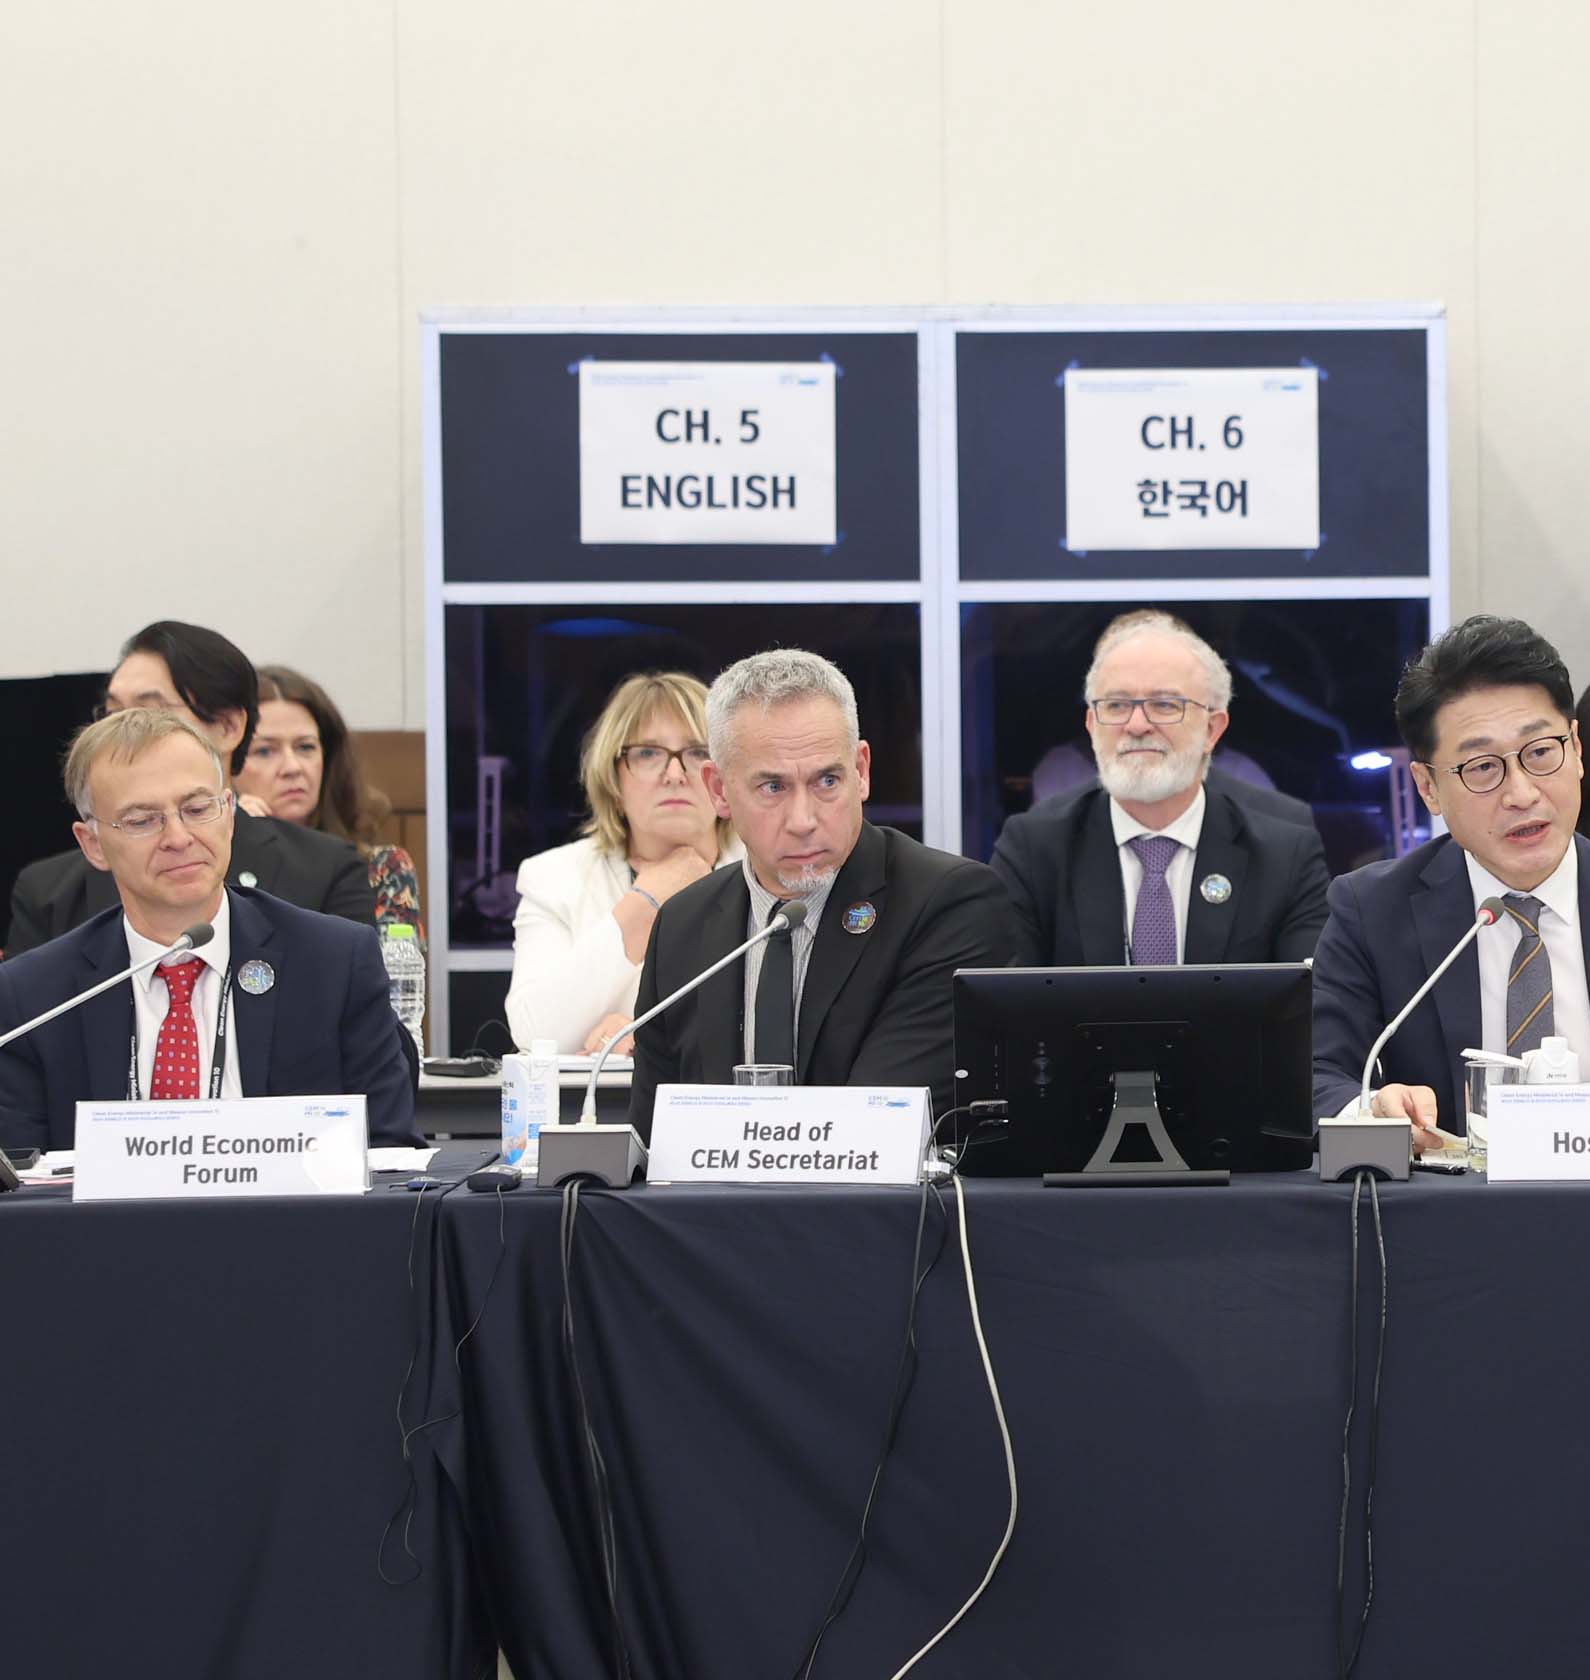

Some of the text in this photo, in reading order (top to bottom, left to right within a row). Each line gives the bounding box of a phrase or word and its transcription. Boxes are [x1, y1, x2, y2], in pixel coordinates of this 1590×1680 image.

[655, 408, 760, 445] CH. 5
[1140, 415, 1244, 451] CH. 6
[620, 474, 796, 510] ENGLISH
[1136, 478, 1248, 518] 한국어
[124, 1132, 319, 1157] World Economic
[743, 1121, 834, 1142] Head of
[183, 1164, 258, 1185] Forum
[690, 1148, 880, 1171] CEM Secretariat
